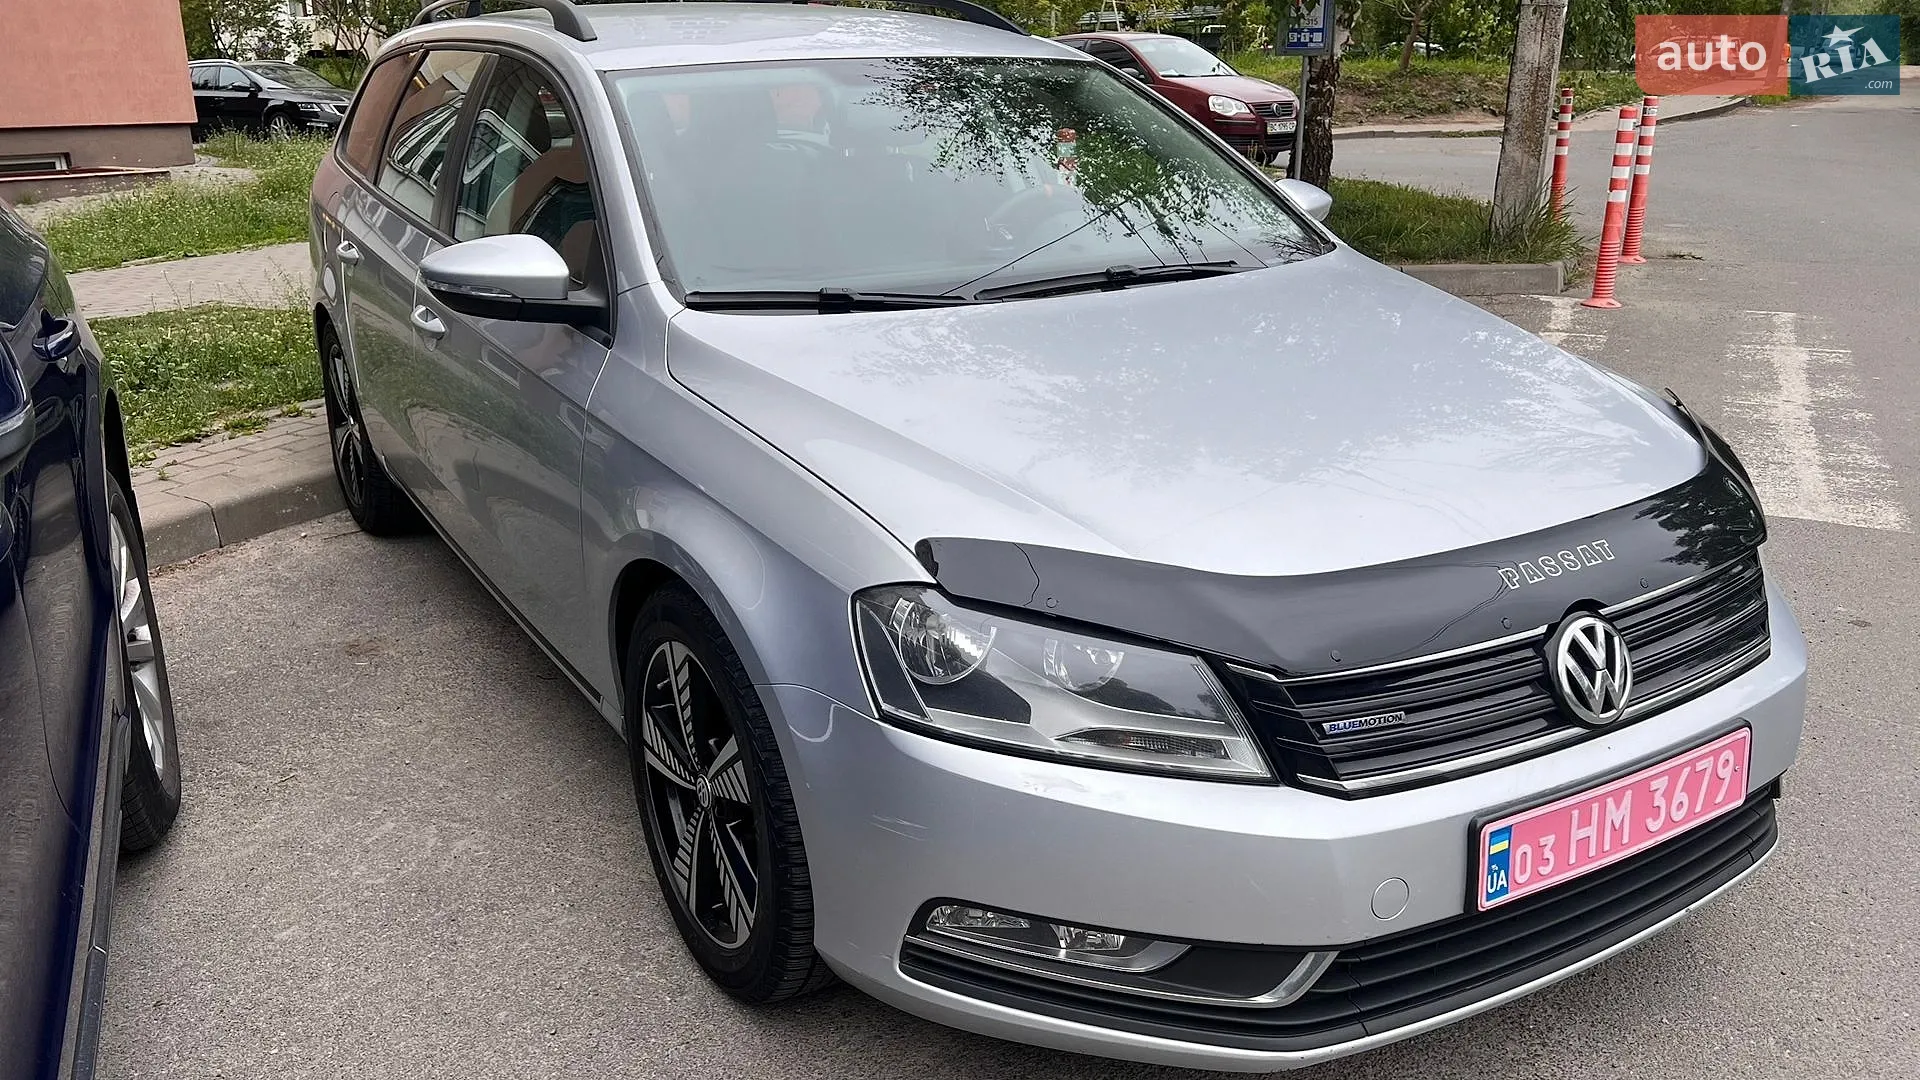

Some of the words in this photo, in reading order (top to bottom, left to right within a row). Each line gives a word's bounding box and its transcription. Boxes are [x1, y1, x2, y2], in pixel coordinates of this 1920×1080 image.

[1498, 539, 1615, 590] PASSAT
[1329, 714, 1404, 732] BLUEMOTION
[1514, 833, 1556, 884] 03
[1568, 790, 1632, 865] HM
[1645, 749, 1735, 832] 3679
[1487, 870, 1507, 893] UA
